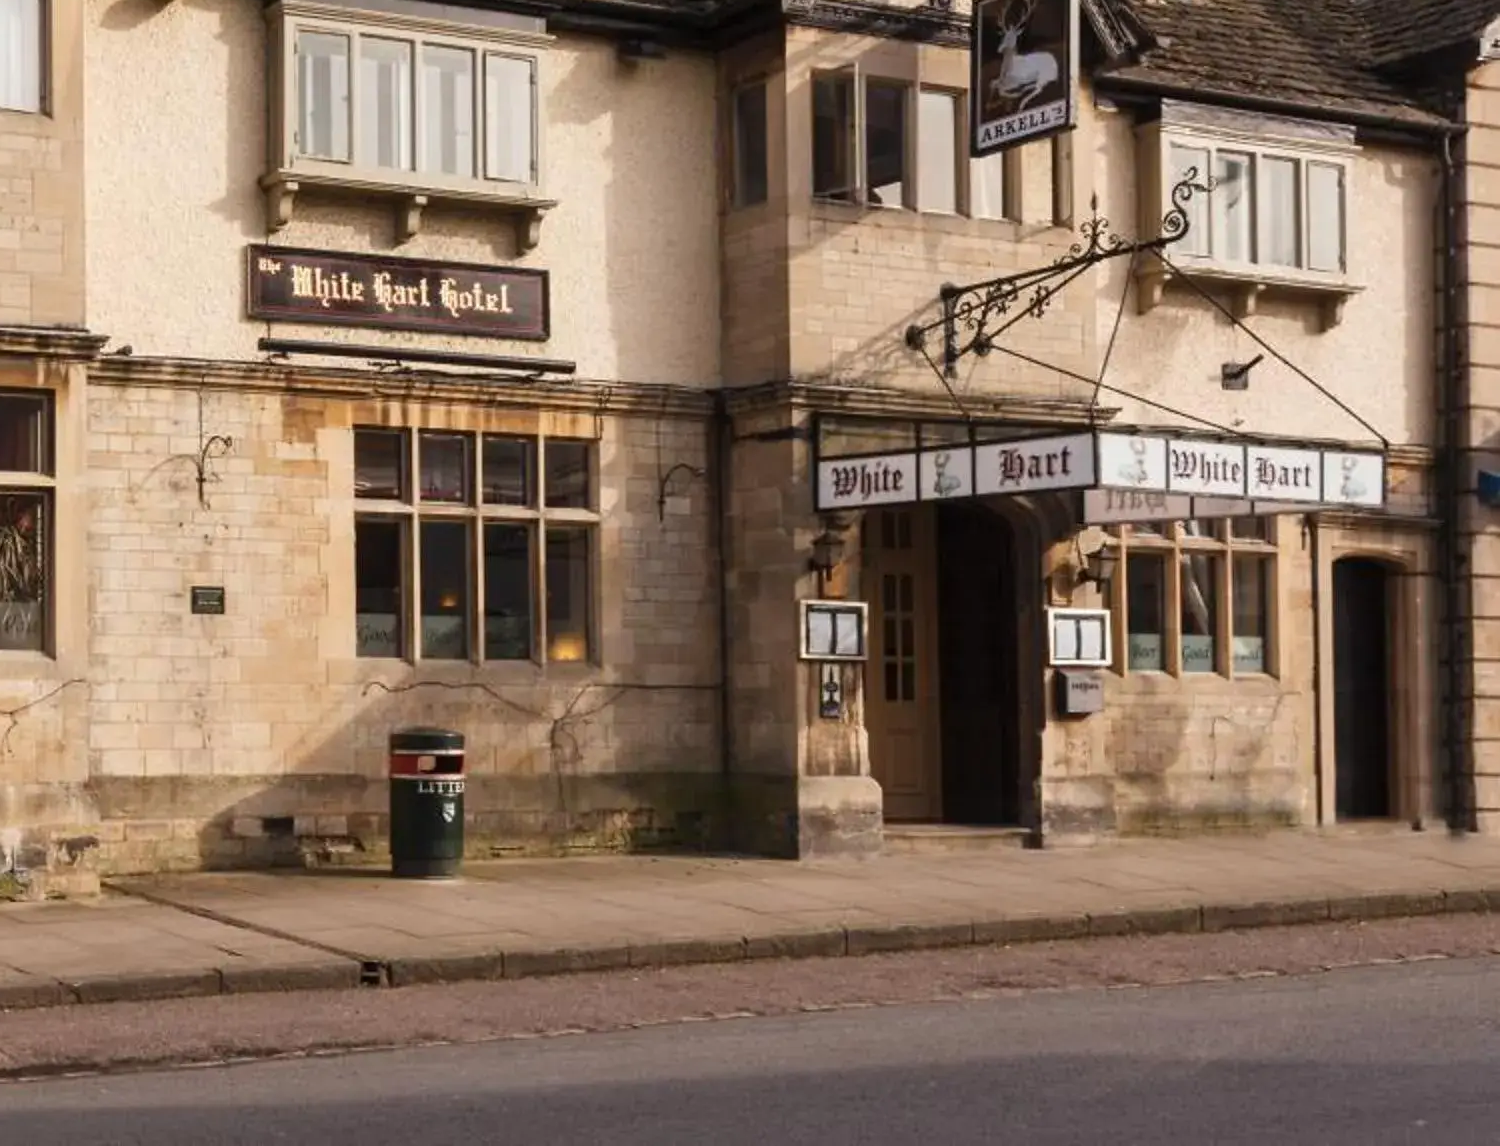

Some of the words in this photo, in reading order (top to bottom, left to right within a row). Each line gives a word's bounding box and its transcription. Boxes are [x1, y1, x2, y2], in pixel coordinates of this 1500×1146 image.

[291, 264, 364, 307] White
[372, 270, 431, 313] Hart
[439, 276, 514, 319] Hotel
[831, 461, 905, 501] White
[998, 445, 1073, 487] Hart
[1171, 448, 1241, 487] White
[1255, 456, 1312, 491] Hart
